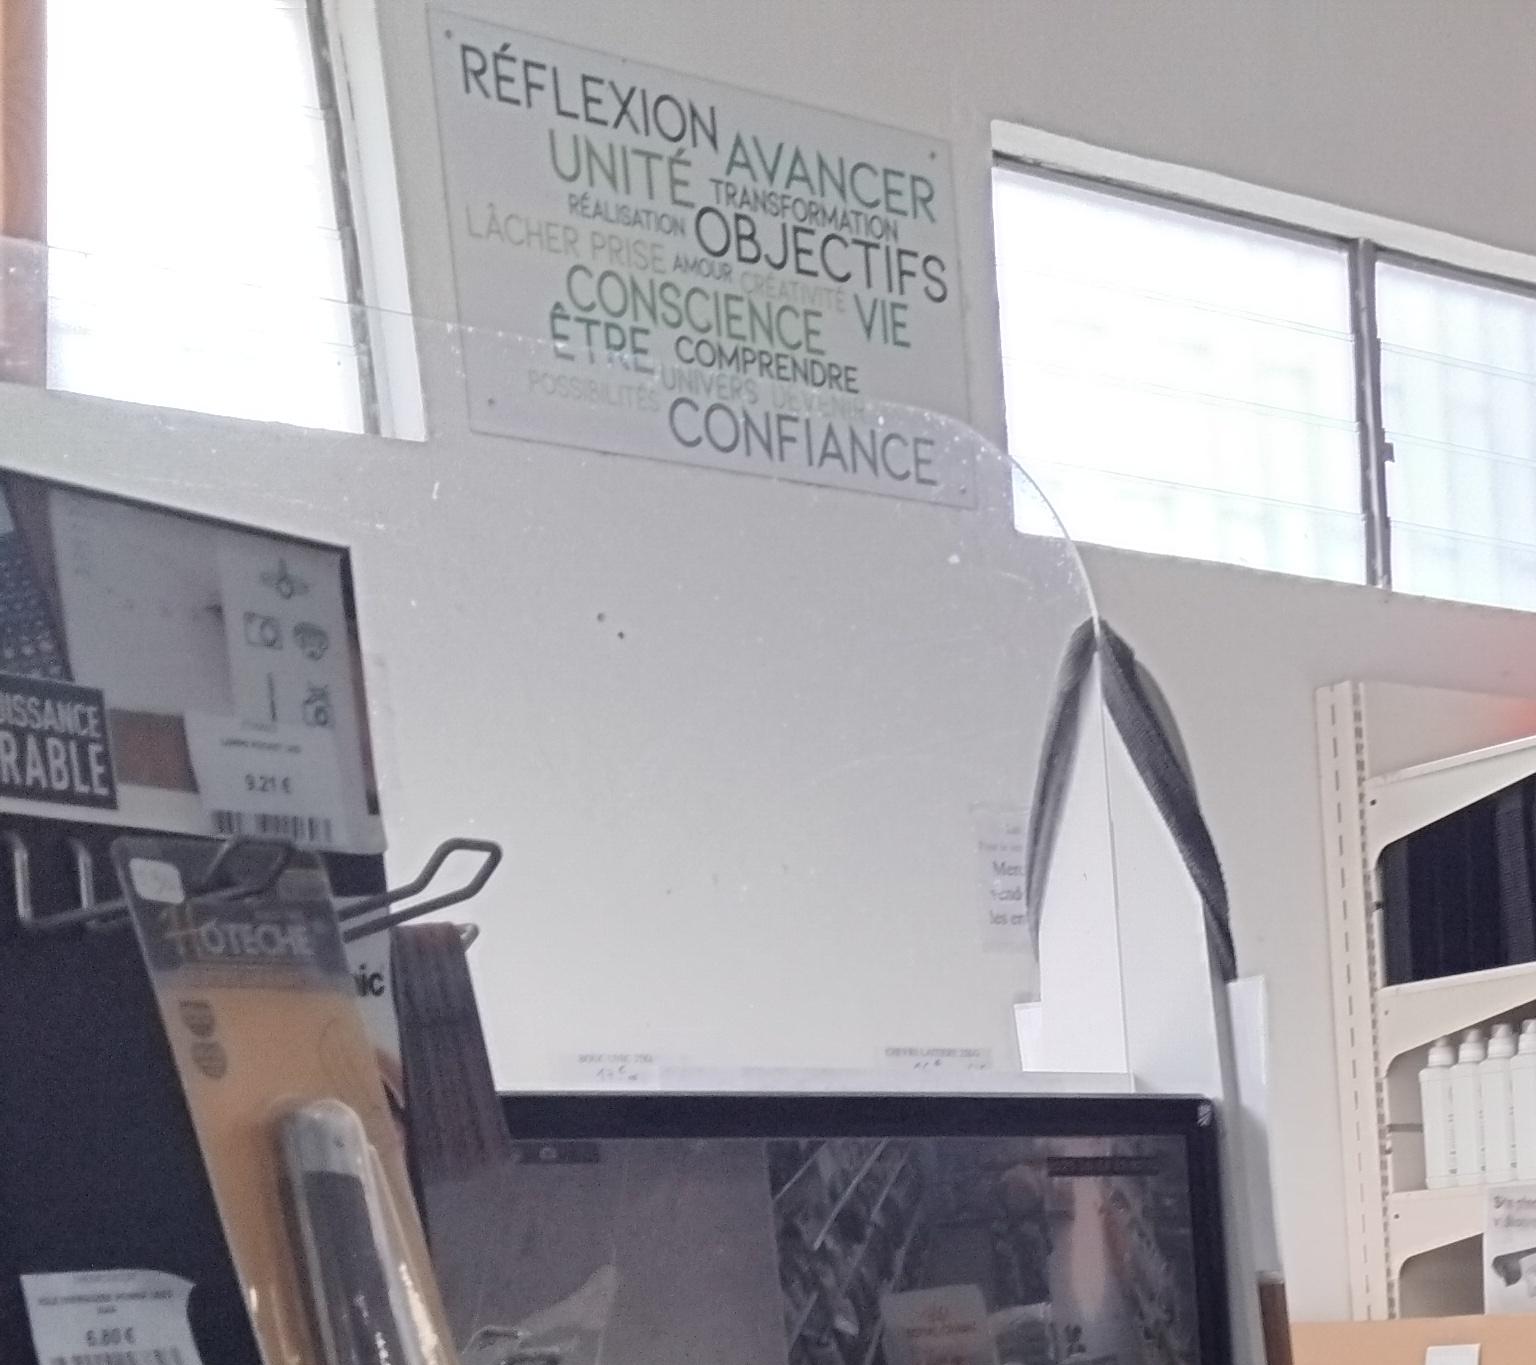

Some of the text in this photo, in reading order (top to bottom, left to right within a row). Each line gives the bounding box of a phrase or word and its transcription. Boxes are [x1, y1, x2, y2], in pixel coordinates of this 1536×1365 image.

[461, 43, 718, 153] RÉFLEXION
[549, 128, 695, 209] UNITÉ
[726, 131, 936, 223] AVANCER
[466, 203, 667, 275] LÂCHER PRISE
[568, 191, 687, 237] RÉALISATION
[709, 177, 899, 242] TRANSFORMATION
[673, 255, 732, 283] AMOUR
[695, 206, 948, 304] OBJECTIFS
[551, 301, 655, 374] ÊTRE
[567, 264, 825, 355] CONSCIENCE
[854, 293, 911, 348] VIE
[661, 366, 758, 405] UNIVERS
[675, 335, 859, 394] COMPRENDRE
[669, 397, 938, 486] CONFIANCE
